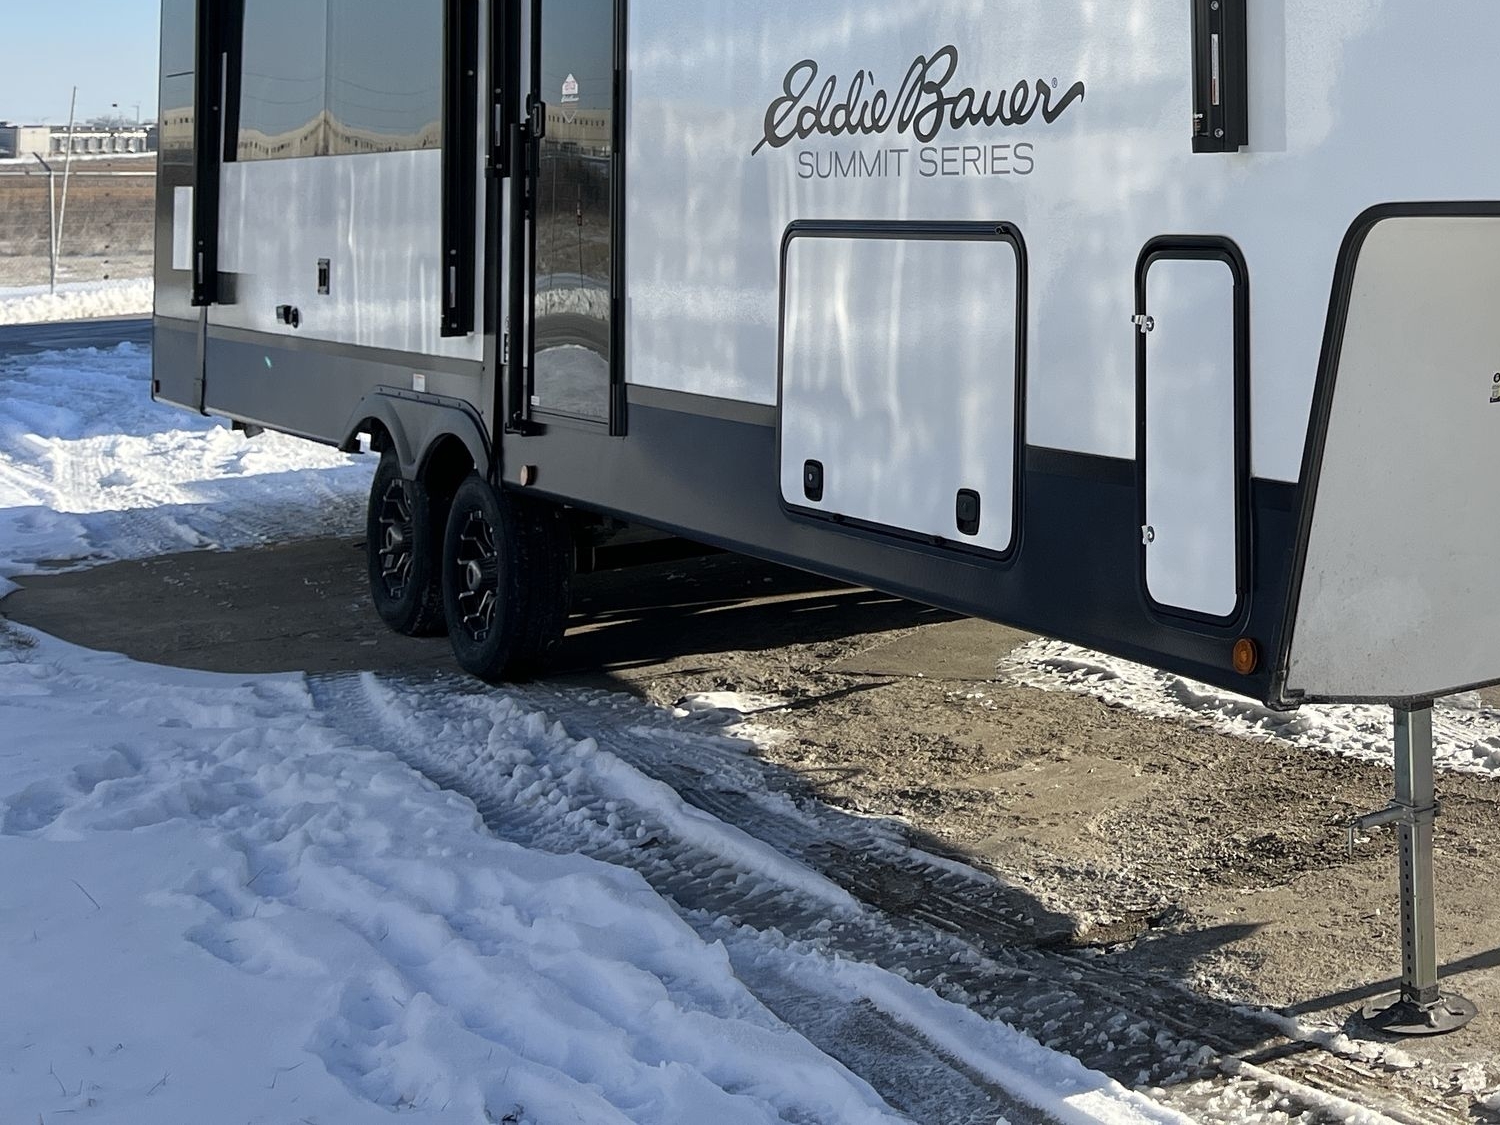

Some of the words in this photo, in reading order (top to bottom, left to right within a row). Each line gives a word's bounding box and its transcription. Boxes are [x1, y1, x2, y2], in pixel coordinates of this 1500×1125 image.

[751, 59, 892, 157] Eddie
[897, 44, 1086, 143] Bauer
[797, 148, 909, 179] SUMMIT
[918, 142, 1035, 178] SERIES
